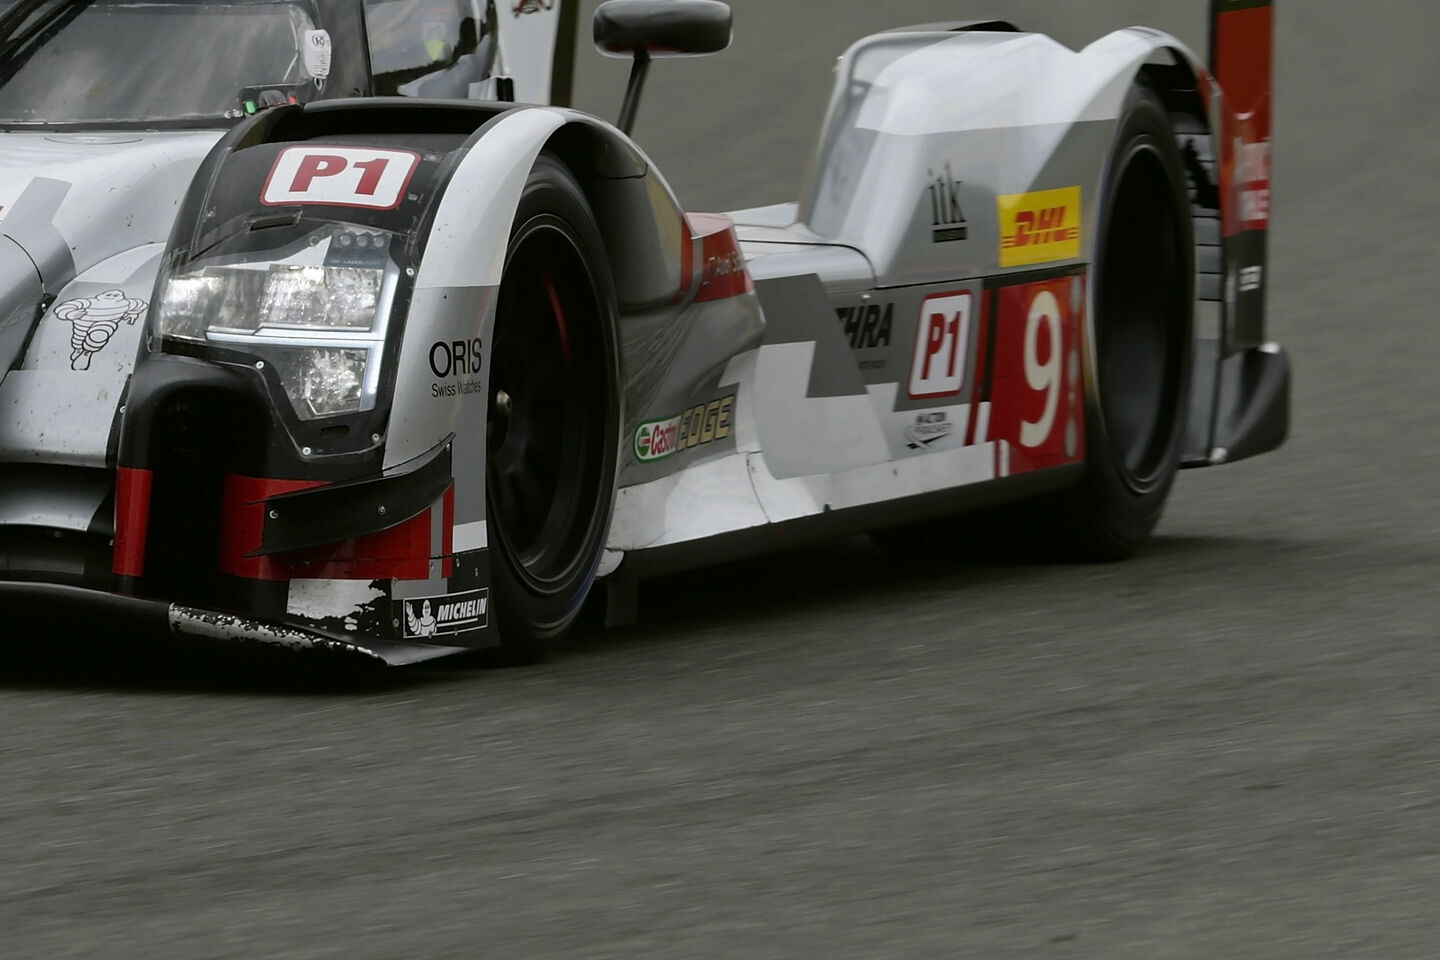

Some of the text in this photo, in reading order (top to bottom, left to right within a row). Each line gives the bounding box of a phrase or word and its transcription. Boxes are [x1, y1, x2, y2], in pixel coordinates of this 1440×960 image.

[288, 155, 391, 196] P1
[1015, 206, 1067, 247] DHL
[429, 337, 482, 378] ORIS
[920, 310, 962, 380] P1
[432, 381, 481, 397] Swiss Watches
[1020, 290, 1063, 448] 9
[677, 394, 735, 452] EDGE
[437, 597, 487, 622] MICHELIN
